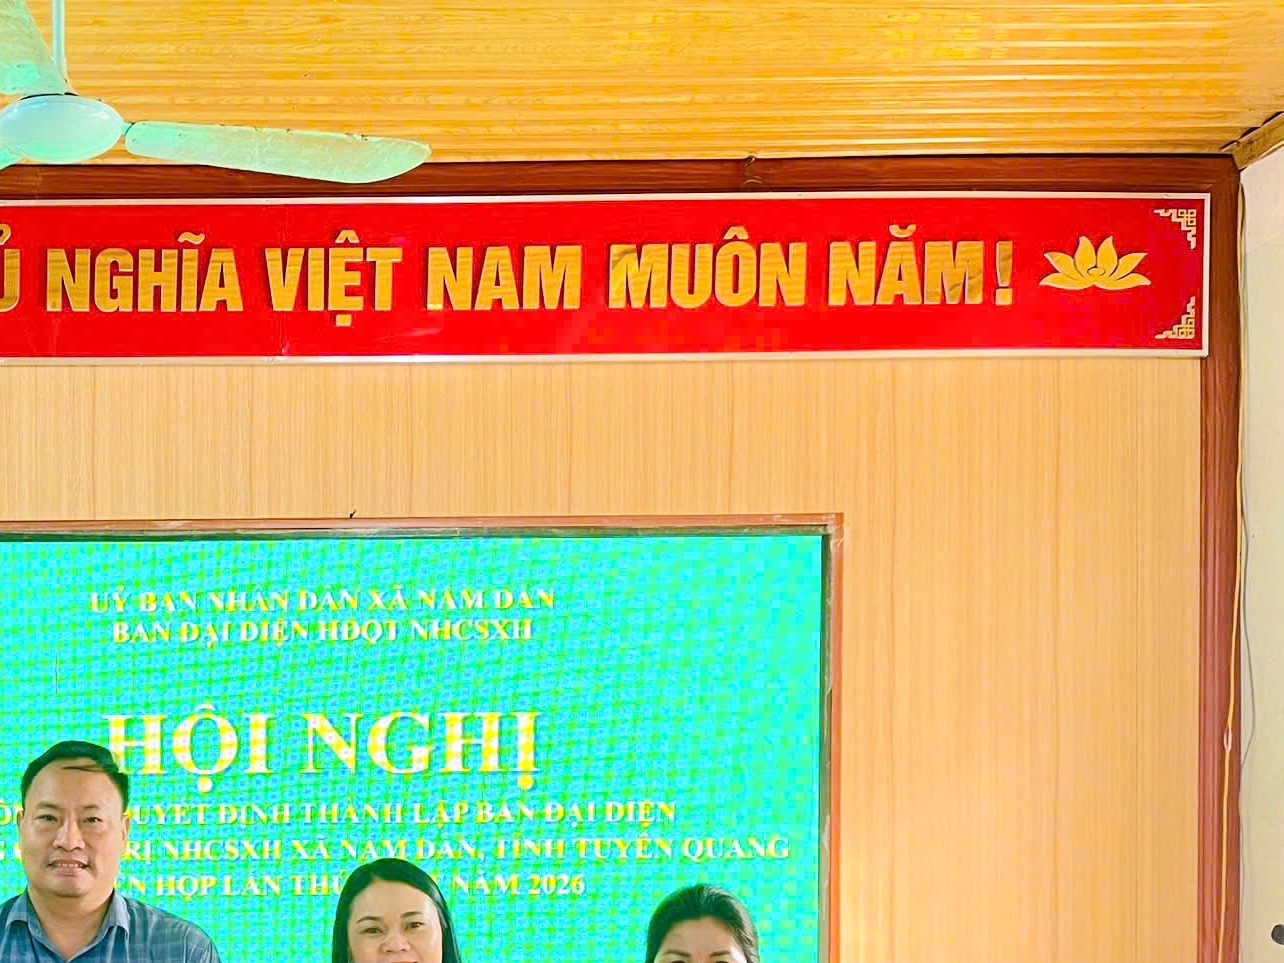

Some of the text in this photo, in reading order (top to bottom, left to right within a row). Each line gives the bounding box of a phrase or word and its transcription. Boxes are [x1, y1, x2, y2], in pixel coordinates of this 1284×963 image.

[46, 232, 243, 313] NGHĨA
[264, 227, 404, 327] VIỆT
[426, 243, 582, 311] NAM
[608, 226, 807, 308] MUÔN
[412, 618, 532, 641] NHCSXH
[103, 703, 542, 793] HỘI NGHỊ
[123, 800, 205, 825] UYẾT
[165, 840, 282, 862] NHCSXH
[683, 836, 791, 863] QUANG
[527, 873, 586, 895] 2026
